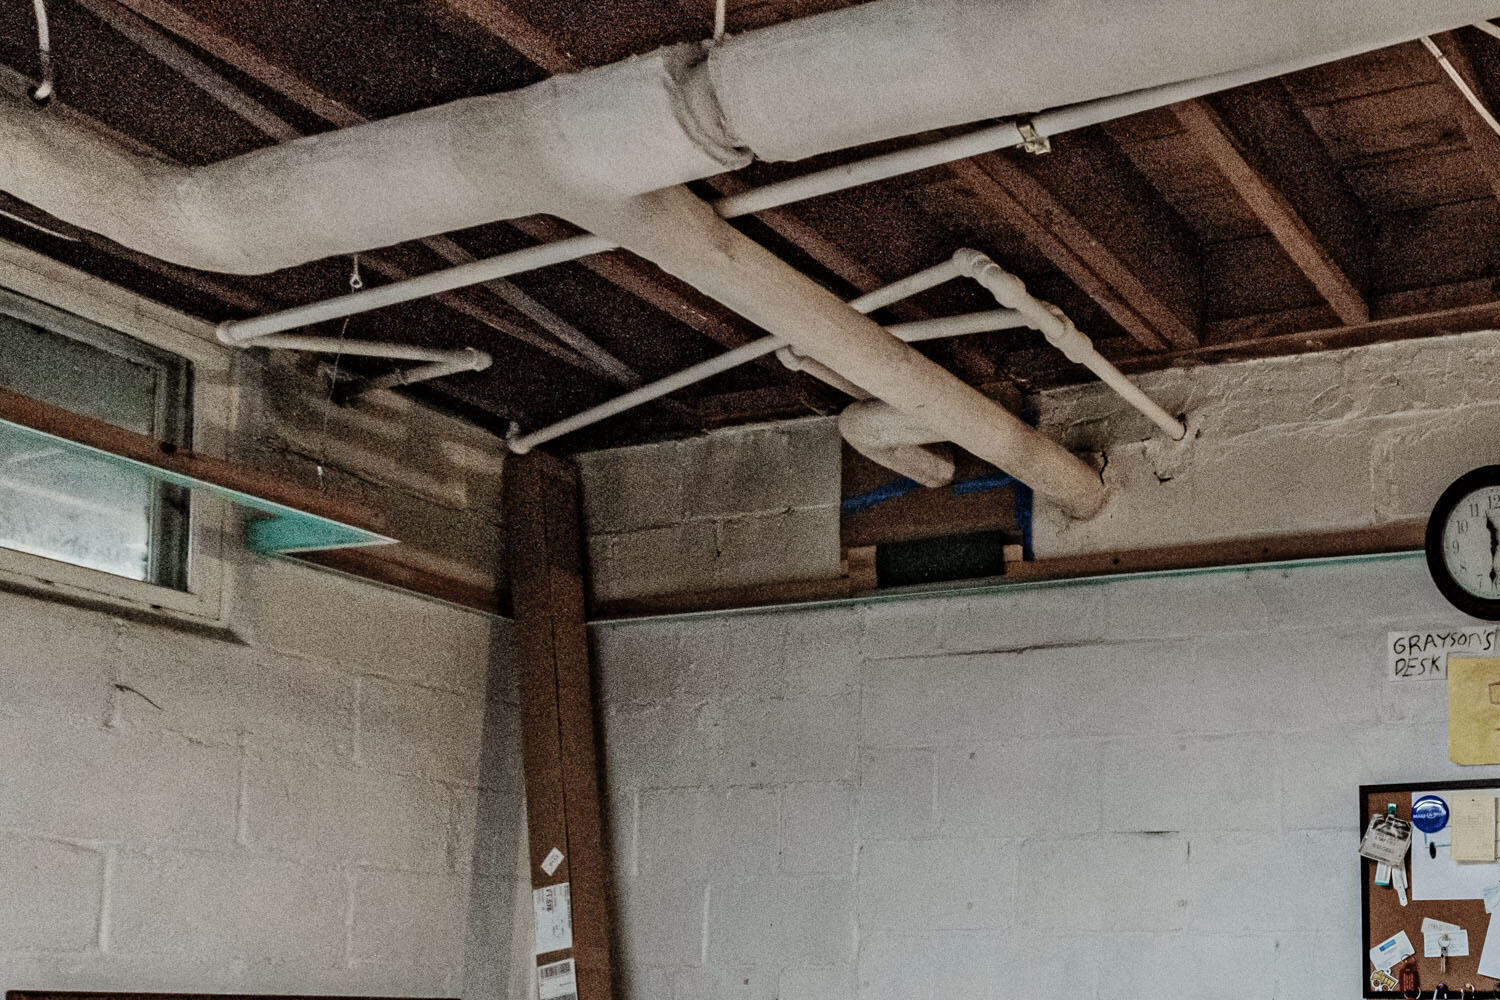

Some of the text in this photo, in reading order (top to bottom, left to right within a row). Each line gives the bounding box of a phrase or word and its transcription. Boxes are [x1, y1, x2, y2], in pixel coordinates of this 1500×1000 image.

[1487, 494, 1500, 509] 12
[1469, 503, 1479, 517] 11
[1456, 520, 1469, 534] 10
[1452, 540, 1460, 554] 9
[1394, 656, 1441, 677] DESK
